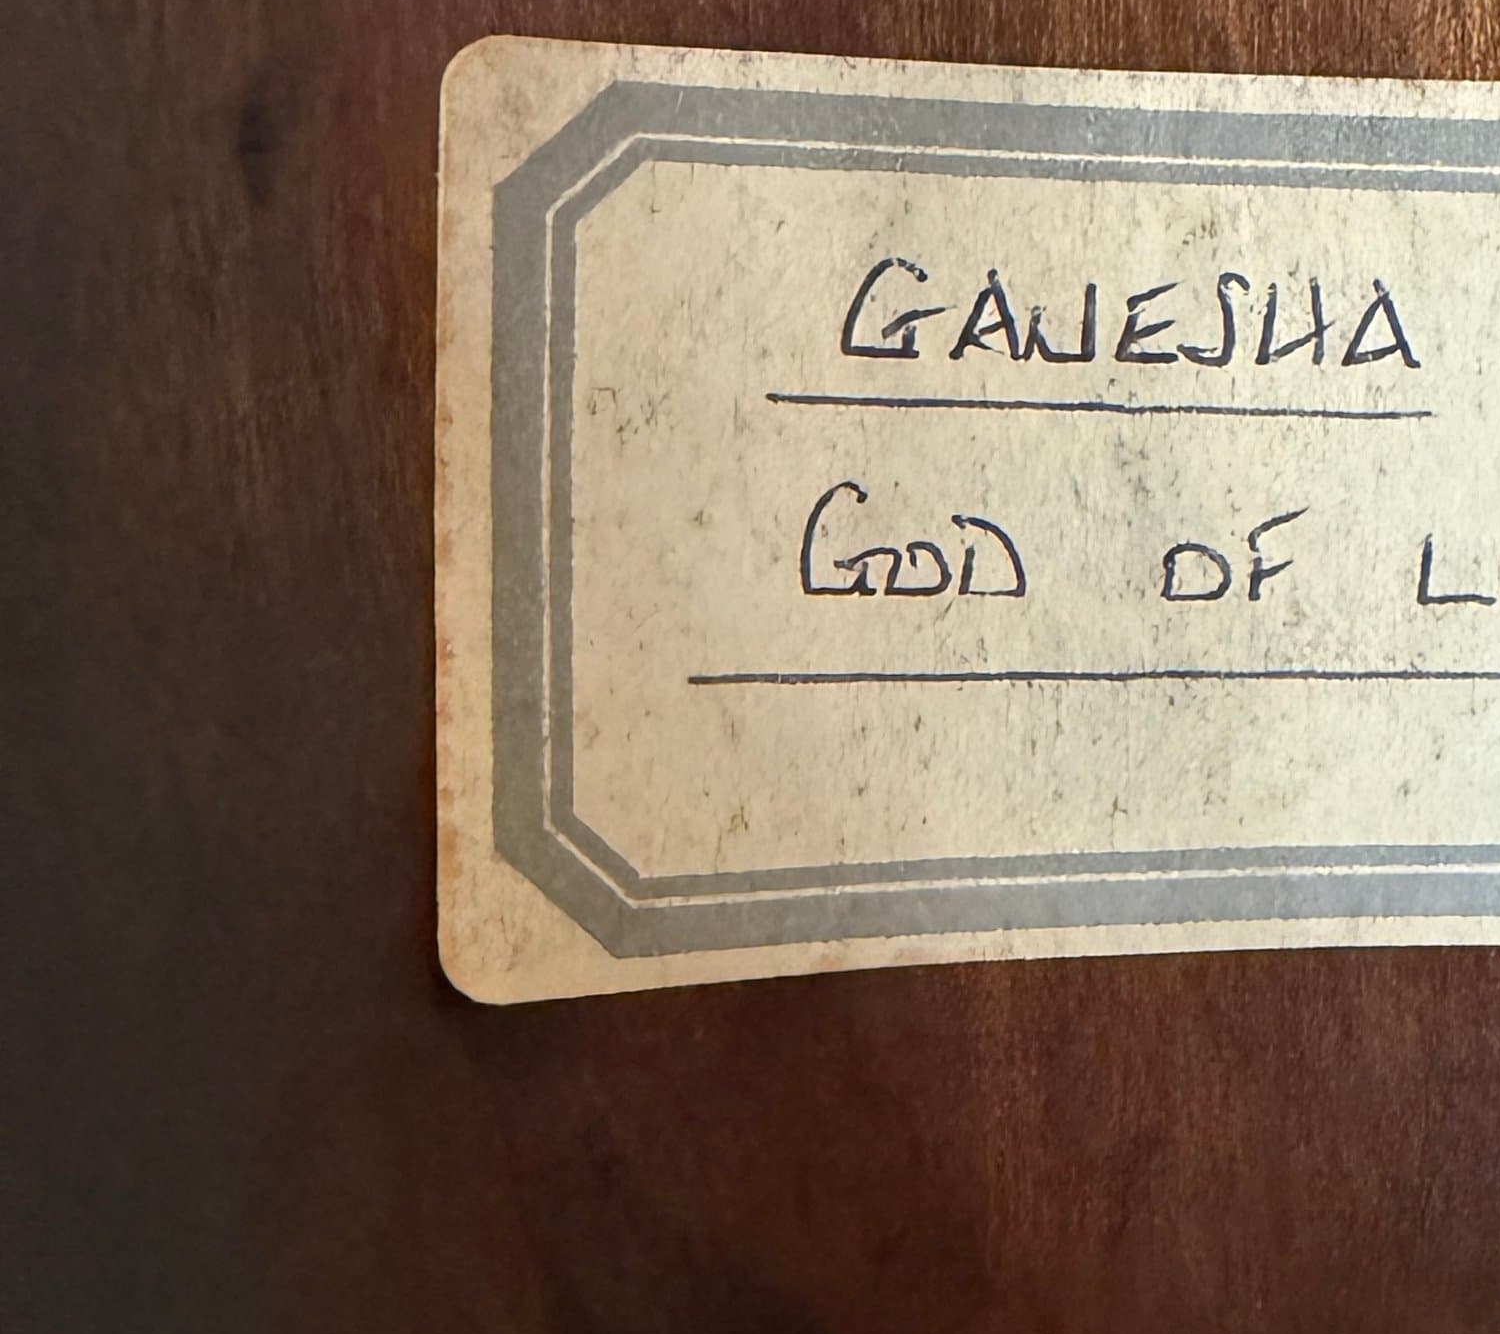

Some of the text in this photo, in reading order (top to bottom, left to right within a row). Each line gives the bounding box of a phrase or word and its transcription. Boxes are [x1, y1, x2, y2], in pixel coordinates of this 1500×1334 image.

[841, 256, 1422, 369] GANESHA
[800, 479, 1028, 598] GOD
[1161, 506, 1310, 602] OF
